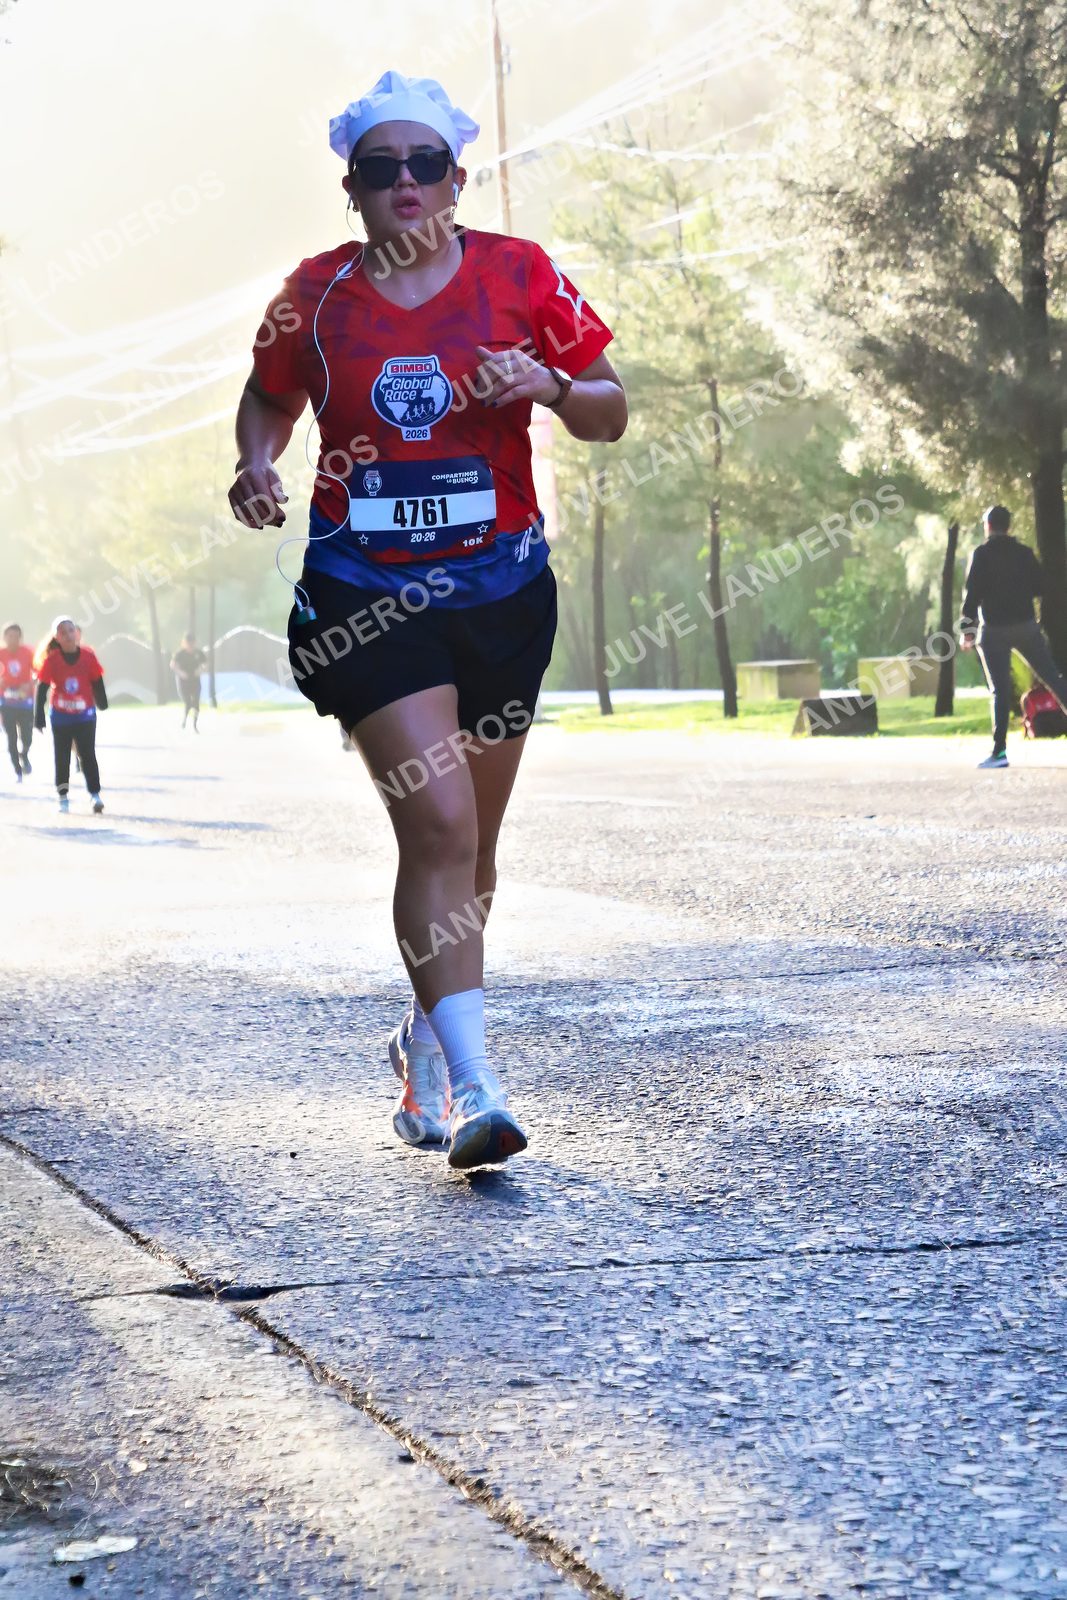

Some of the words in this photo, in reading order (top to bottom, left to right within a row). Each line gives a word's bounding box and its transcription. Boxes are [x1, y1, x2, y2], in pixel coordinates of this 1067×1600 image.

[390, 363, 432, 373] BIMBO
[391, 376, 432, 390] Global
[384, 389, 417, 402] Race
[405, 429, 428, 439] 2026
[431, 470, 478, 480] COMPARTIMOS
[393, 497, 449, 528] 4761
[462, 536, 484, 548] 10K
